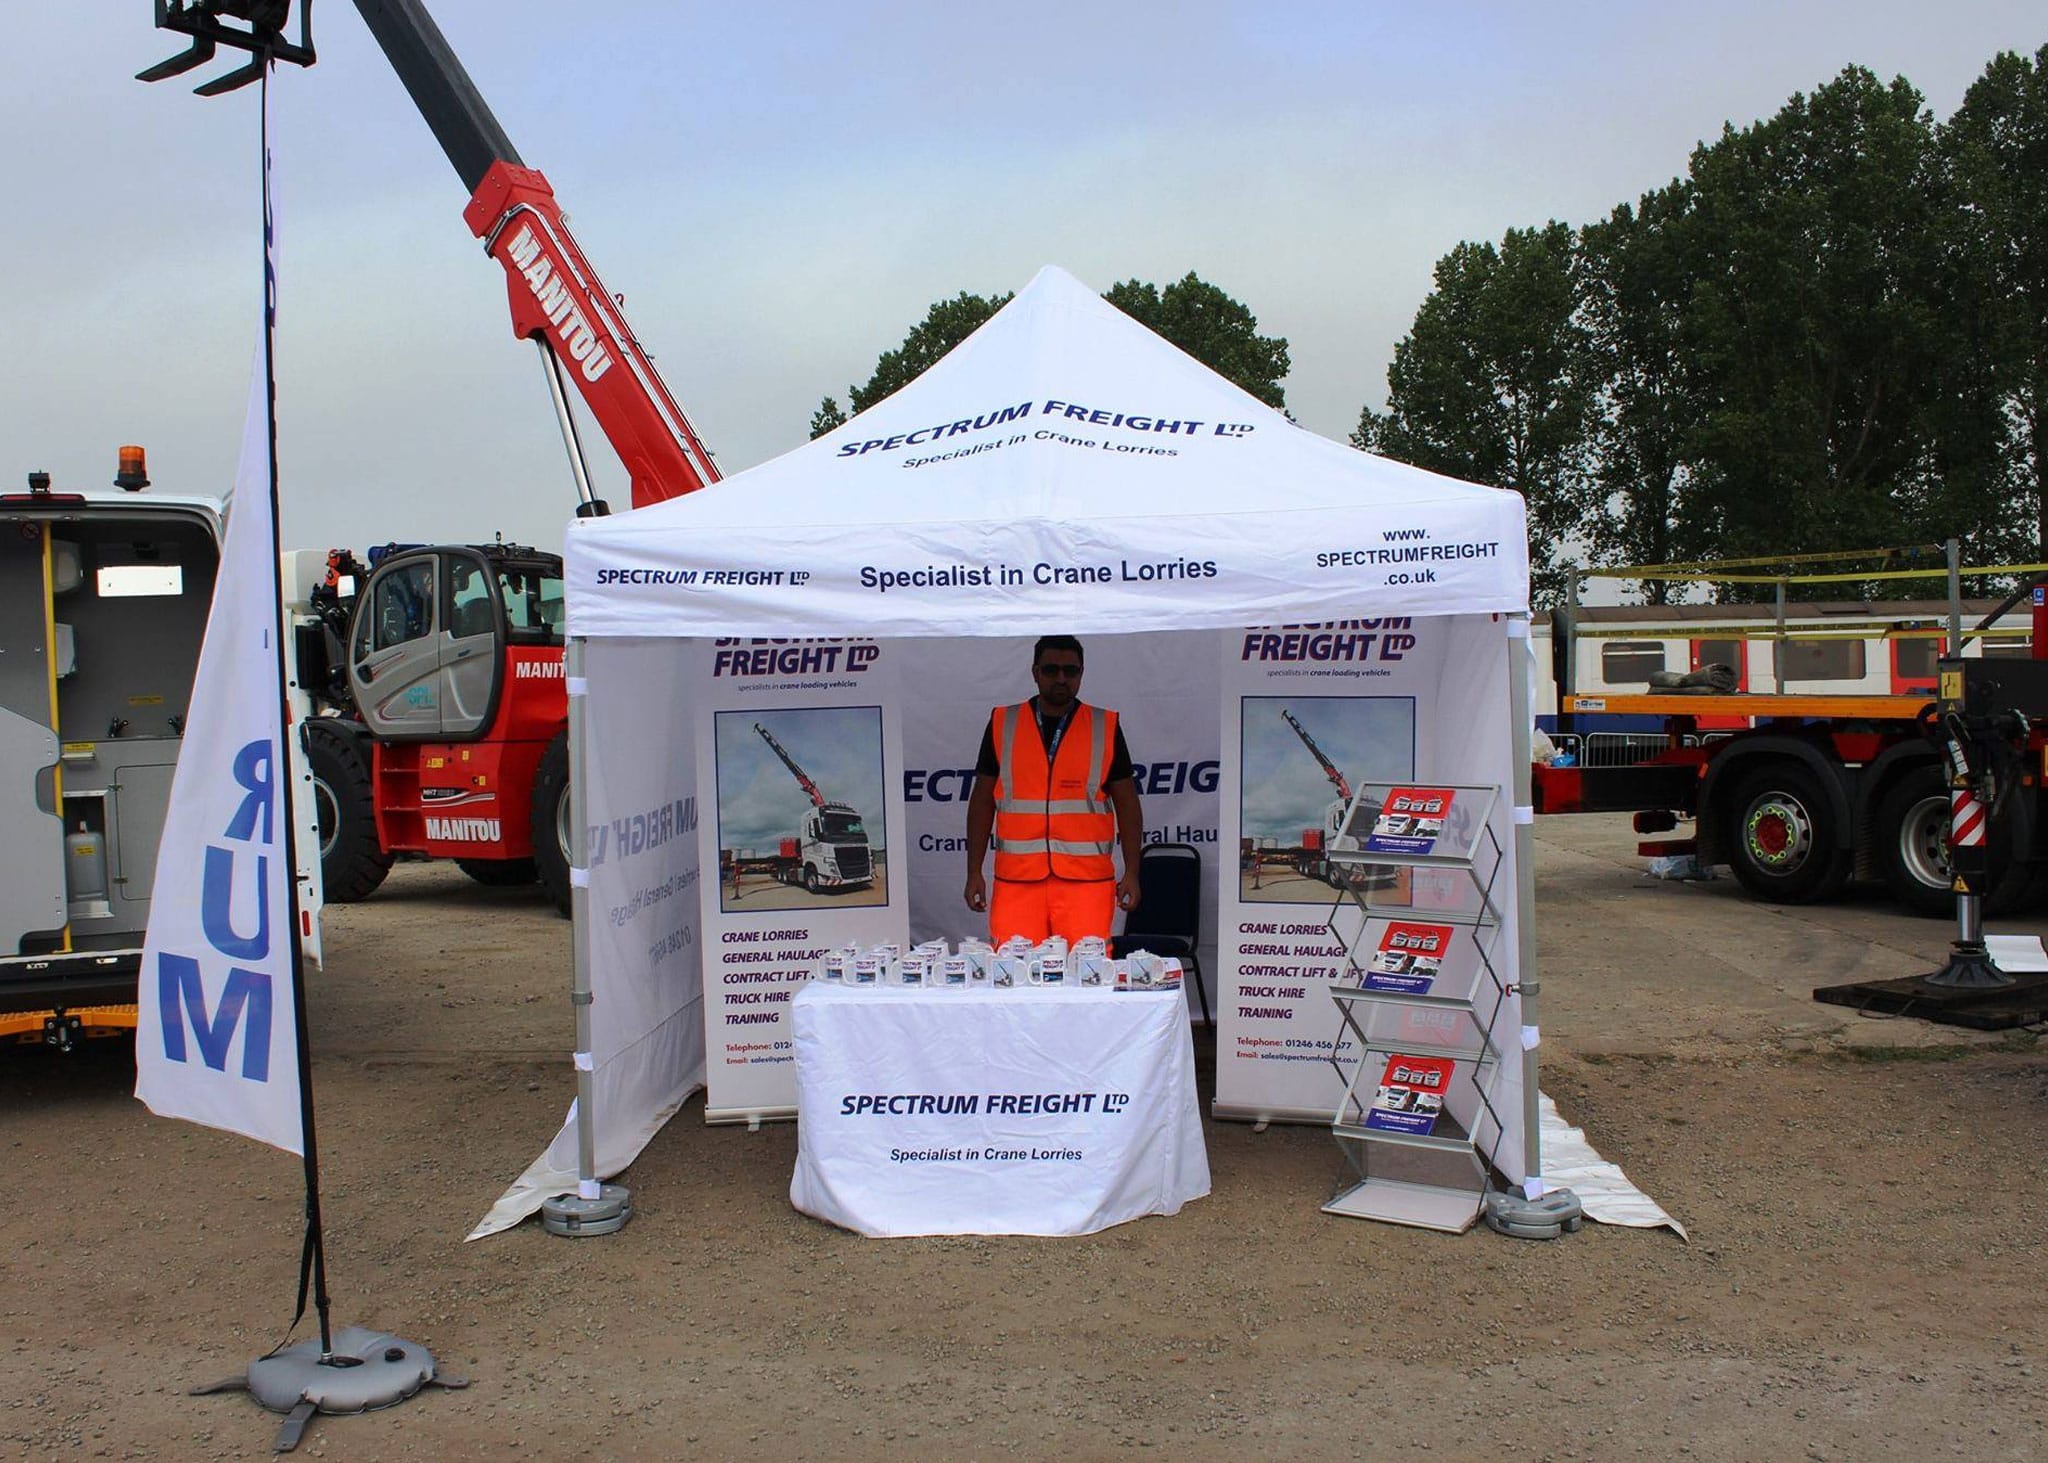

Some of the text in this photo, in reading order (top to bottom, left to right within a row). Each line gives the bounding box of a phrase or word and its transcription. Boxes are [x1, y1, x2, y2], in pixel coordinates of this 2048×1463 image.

[507, 221, 615, 382] MANITOU
[837, 401, 1033, 458] SPECTRUM
[1042, 400, 1208, 436] FREIGHT
[902, 429, 1179, 469] Specialist in Crane Lorries
[1383, 528, 1431, 542] www.
[1316, 542, 1499, 568] SPECTRUMFREIGHT
[597, 569, 698, 585] SPECTRUM
[702, 571, 784, 586] FREIGHT
[860, 556, 1218, 593] Specialist in Crane Lorries
[1383, 569, 1436, 586] .co.uk
[1241, 633, 1377, 661] FREIGHT
[713, 646, 843, 677] FREIGHT
[1331, 668, 1360, 678] loading
[1361, 668, 1391, 677] vehicles
[800, 680, 828, 690] loading
[829, 680, 857, 688] vehicles
[426, 818, 501, 842] MANITOU
[722, 929, 809, 943] CRANE LORRIES
[1239, 923, 1328, 935] CRANE LORRIES
[722, 951, 774, 963] GENERAL
[777, 949, 830, 962] HAULAG
[1239, 944, 1290, 956] GENERAL
[723, 970, 810, 984] CONTRACT LIFT
[1238, 965, 1300, 977] CONTRACT
[1302, 967, 1326, 978] LIFT
[1328, 968, 1338, 978] &
[725, 991, 791, 1005] TRUCK HIRE
[1238, 985, 1306, 998] TRUCK HIRE
[725, 1012, 779, 1025] TRAINING
[1238, 1007, 1293, 1019] TRAINING
[726, 1042, 772, 1053] Telephone:
[1237, 1037, 1283, 1048] Telephone:
[1285, 1039, 1313, 1048] 01246
[1315, 1041, 1333, 1049] 456
[840, 1094, 979, 1115] SPECTRUM
[985, 1093, 1096, 1114] FREIGHT
[890, 1147, 1083, 1163] Specialist in Crane Lorries
